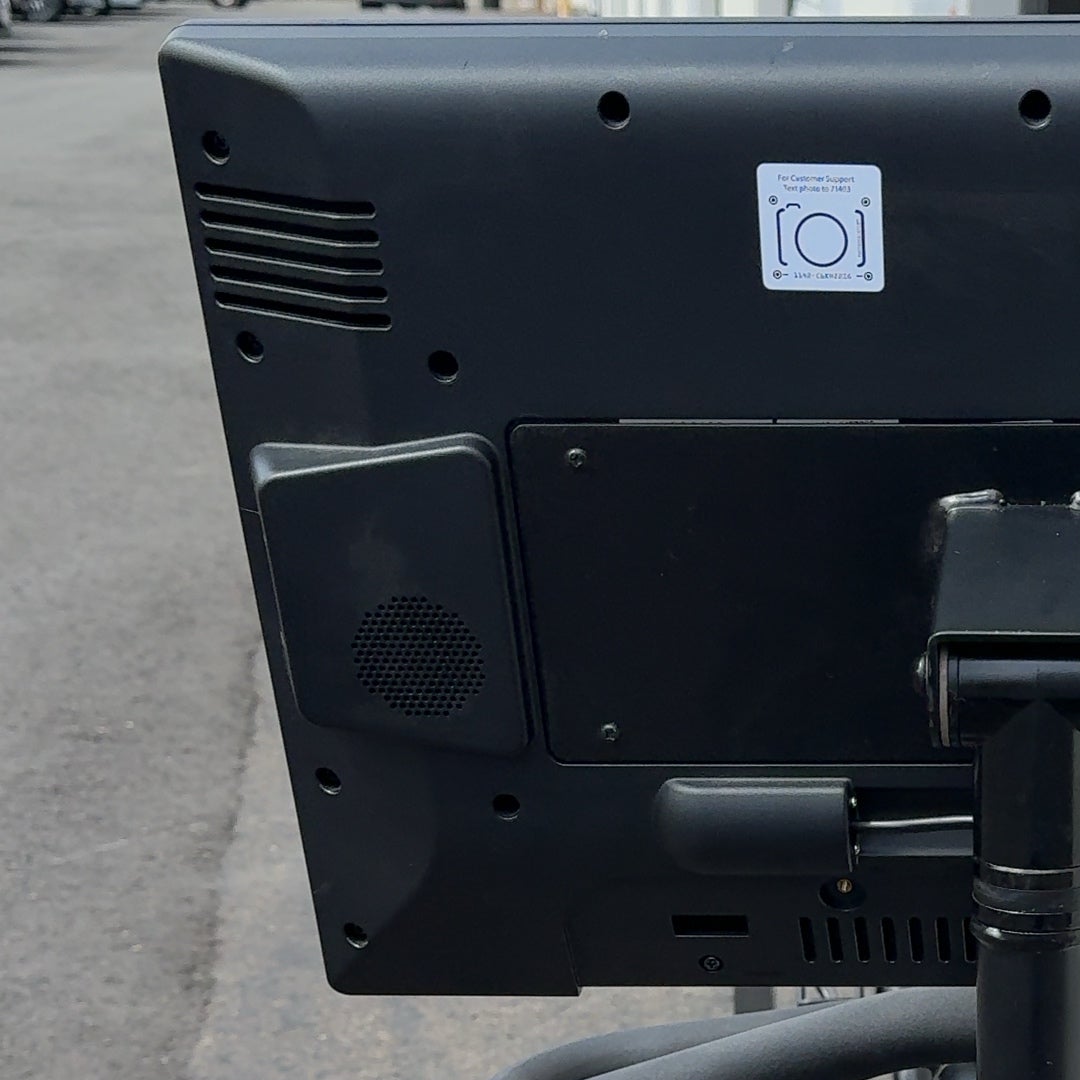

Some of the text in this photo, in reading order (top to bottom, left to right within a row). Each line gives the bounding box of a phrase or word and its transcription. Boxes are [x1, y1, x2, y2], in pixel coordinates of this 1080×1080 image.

[778, 174, 855, 184] For Customer Support
[783, 184, 798, 192] Text
[799, 185, 821, 193] photo
[821, 185, 829, 193] to
